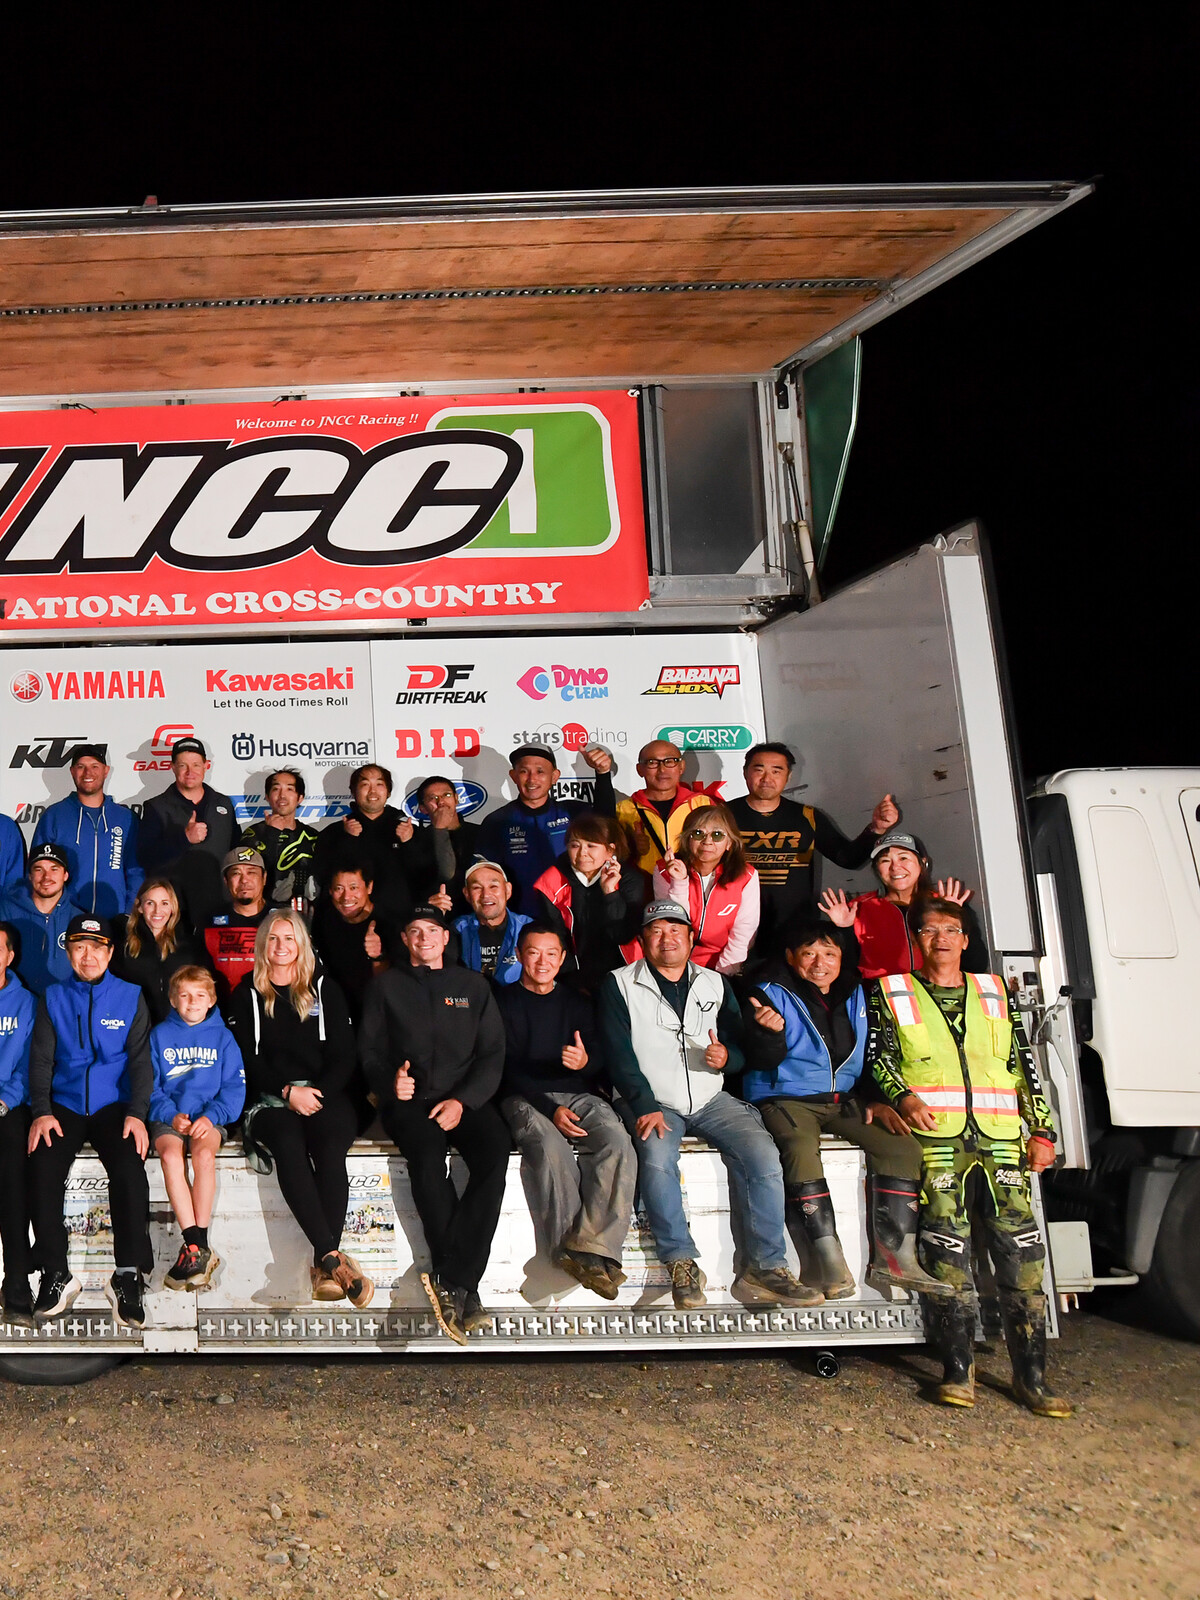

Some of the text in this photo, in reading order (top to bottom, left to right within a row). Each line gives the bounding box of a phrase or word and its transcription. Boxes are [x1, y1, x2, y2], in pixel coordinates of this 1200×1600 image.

[236, 413, 419, 430] Welcome to JNCC Racing !!
[206, 581, 559, 616] CROSS-COUNTRY
[46, 670, 166, 700] YAMAHA
[206, 667, 353, 692] Kawasaki
[406, 664, 475, 690] DF
[551, 664, 609, 688] DYNO
[660, 668, 738, 686] BABANA
[395, 690, 488, 705] DIRTFREAK
[560, 684, 609, 702] CLEAN
[648, 684, 718, 694] SHOX
[213, 697, 348, 709] Let the Good Times Roll
[395, 728, 481, 759] D.I.D
[686, 729, 740, 744] CARRY
[259, 738, 369, 760] Husqvarna
[111, 836, 123, 870] YAMAHA
[176, 1046, 218, 1061] YAMAHA
[996, 1168, 1022, 1178] RIDE
[996, 1175, 1023, 1186] FREE
